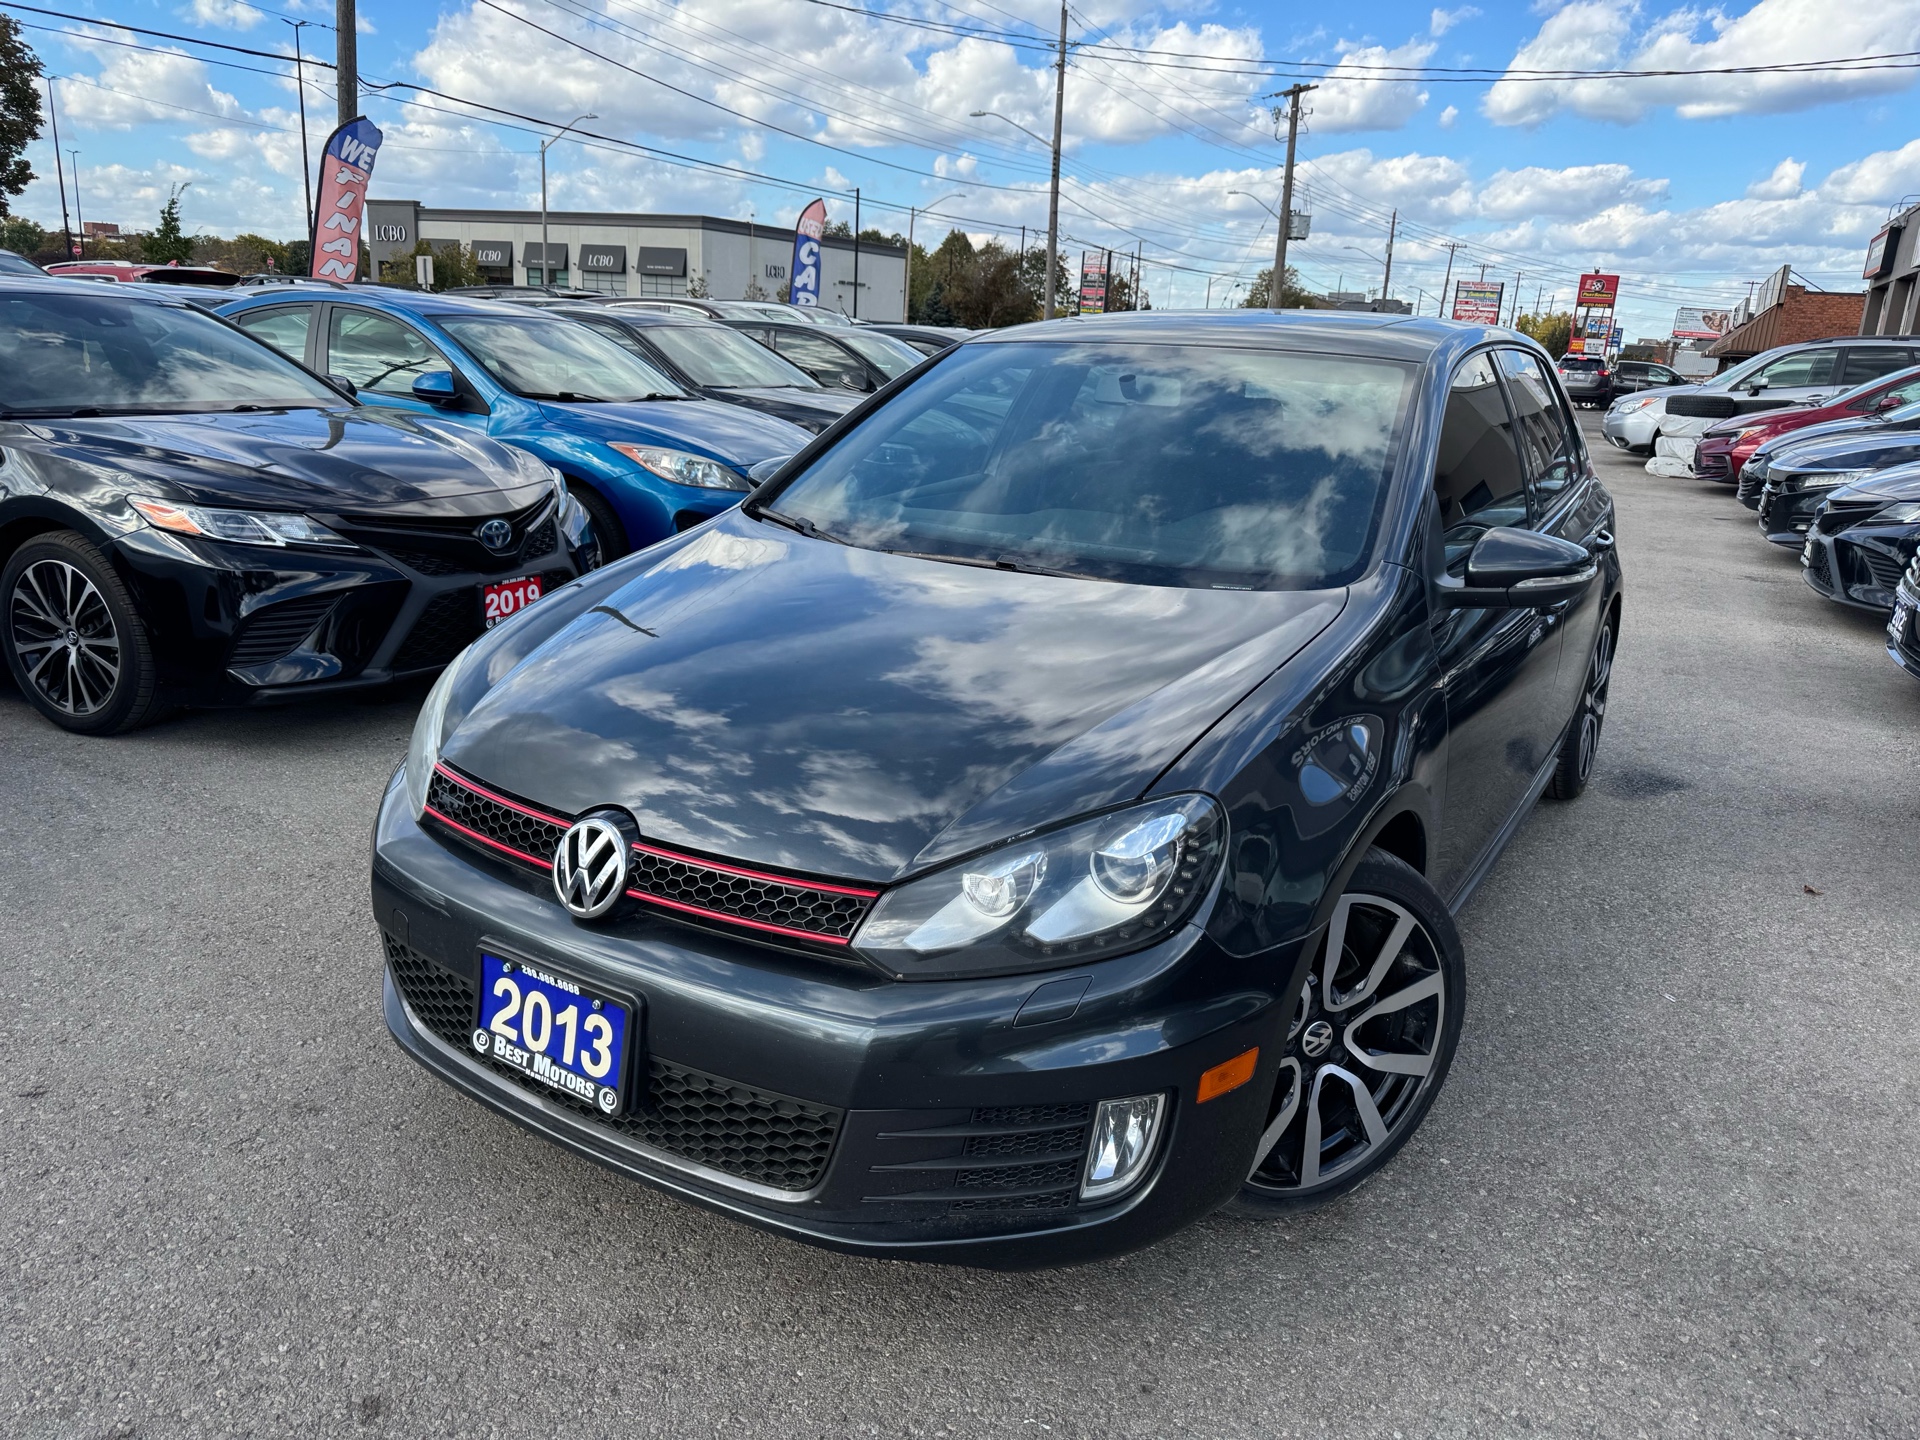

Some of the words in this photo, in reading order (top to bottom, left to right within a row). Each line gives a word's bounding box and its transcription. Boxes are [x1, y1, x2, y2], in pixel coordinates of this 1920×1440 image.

[340, 135, 376, 171] WE
[375, 224, 406, 242] LCBO
[477, 249, 501, 262] LCBO
[588, 254, 614, 267] LCBO
[485, 584, 540, 618] 2019
[489, 977, 613, 1078] 2013
[493, 1034, 530, 1068] BEST
[533, 1053, 595, 1098] MOTORS
[525, 1067, 559, 1089] Hamilton
